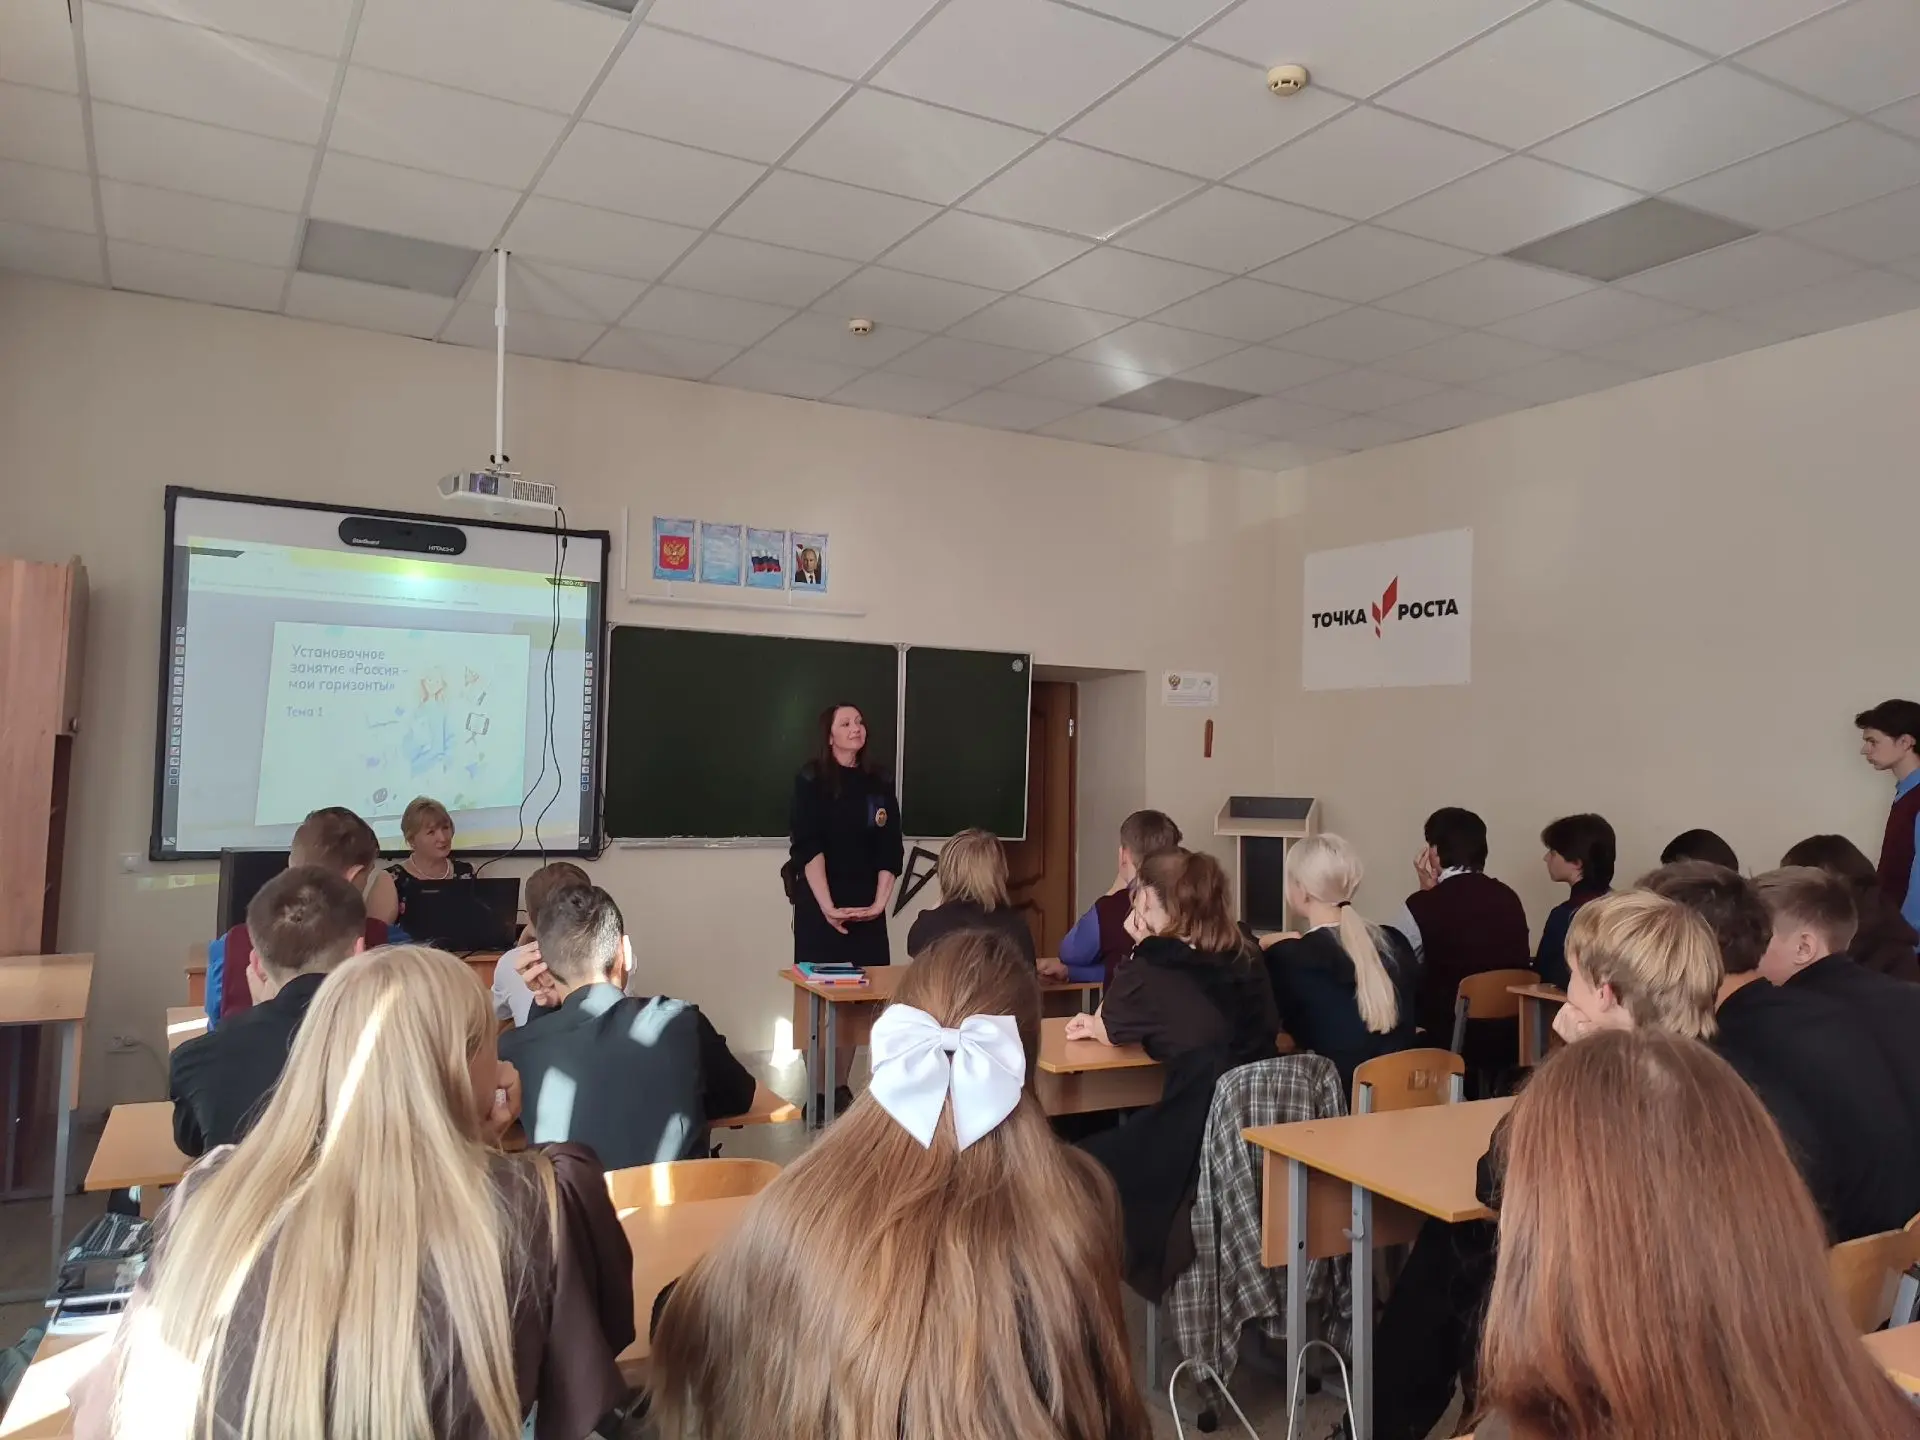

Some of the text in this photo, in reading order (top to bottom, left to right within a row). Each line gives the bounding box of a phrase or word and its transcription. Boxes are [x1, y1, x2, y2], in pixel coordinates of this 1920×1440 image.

[1312, 599, 1459, 628] ТОЧКА РОСТА
[292, 645, 385, 661] Установочное
[289, 663, 345, 674] занятие
[288, 679, 315, 690] мои
[286, 706, 314, 717] Тема
